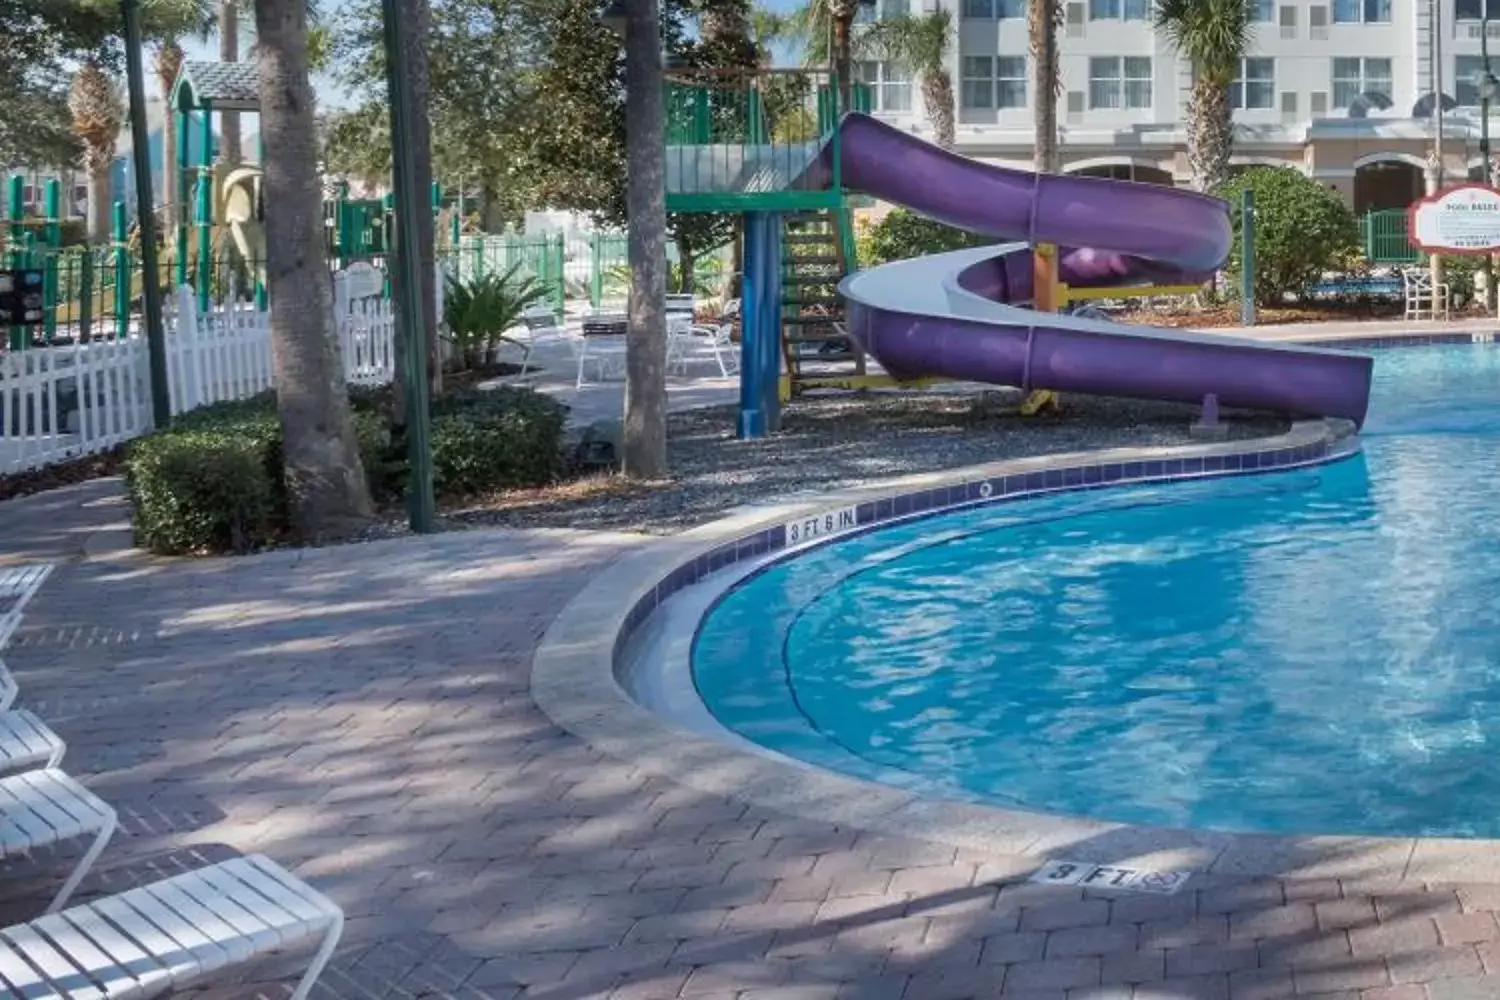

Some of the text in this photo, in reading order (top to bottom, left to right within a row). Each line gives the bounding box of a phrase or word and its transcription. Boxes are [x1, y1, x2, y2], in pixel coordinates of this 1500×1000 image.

[804, 517, 819, 536] FT
[839, 509, 854, 528] IN
[1048, 863, 1136, 885] 3 FT
